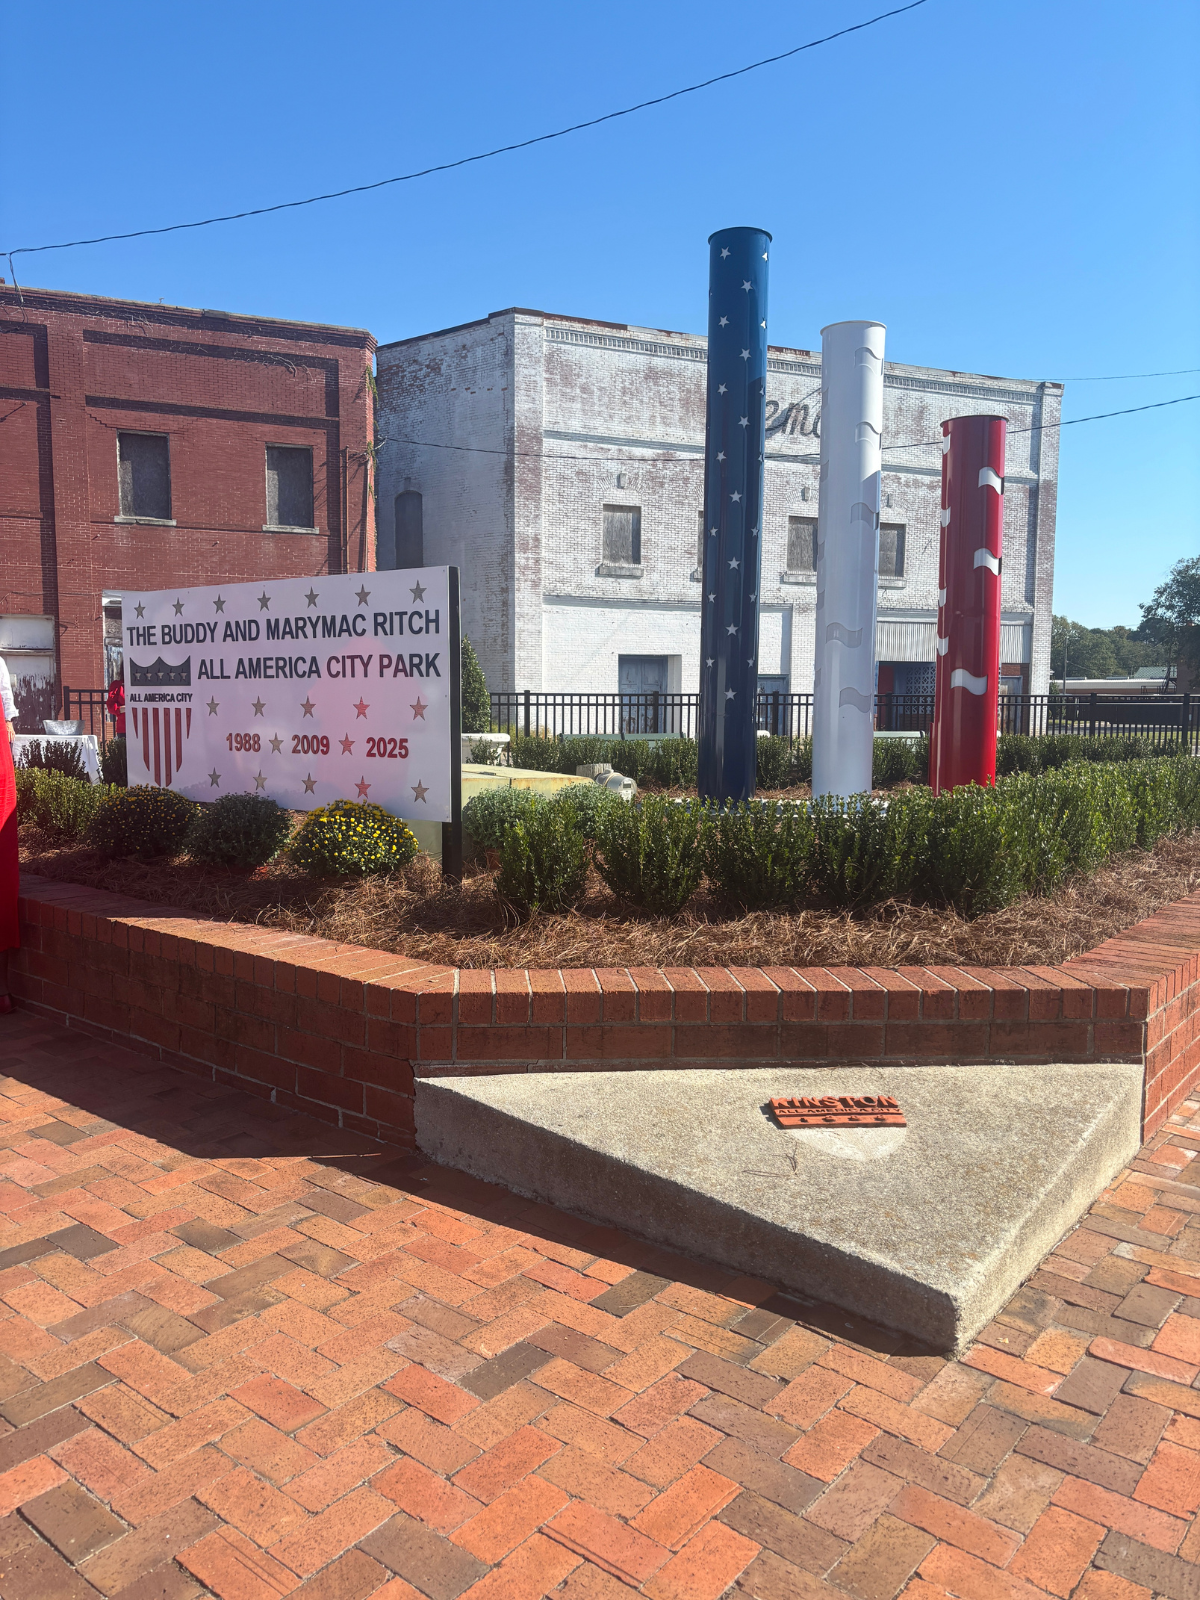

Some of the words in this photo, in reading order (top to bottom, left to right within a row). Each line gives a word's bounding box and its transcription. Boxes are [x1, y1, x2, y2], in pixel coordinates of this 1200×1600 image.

[127, 625, 157, 646] THE
[161, 622, 218, 645] BUDDY
[222, 619, 260, 642] AND
[266, 613, 367, 640] MARYMAC
[373, 609, 440, 636] RITCH
[197, 658, 231, 680] ALL
[234, 655, 321, 679] AMERICA
[326, 654, 373, 678] CITY
[379, 653, 441, 677] PARK
[130, 693, 143, 702] ALL
[144, 693, 175, 702] AMERICA
[176, 693, 193, 702] CITY
[226, 733, 261, 752] 1988
[291, 735, 330, 755] 2009
[366, 738, 409, 759] 2025
[770, 1095, 898, 1109] KINSTON
